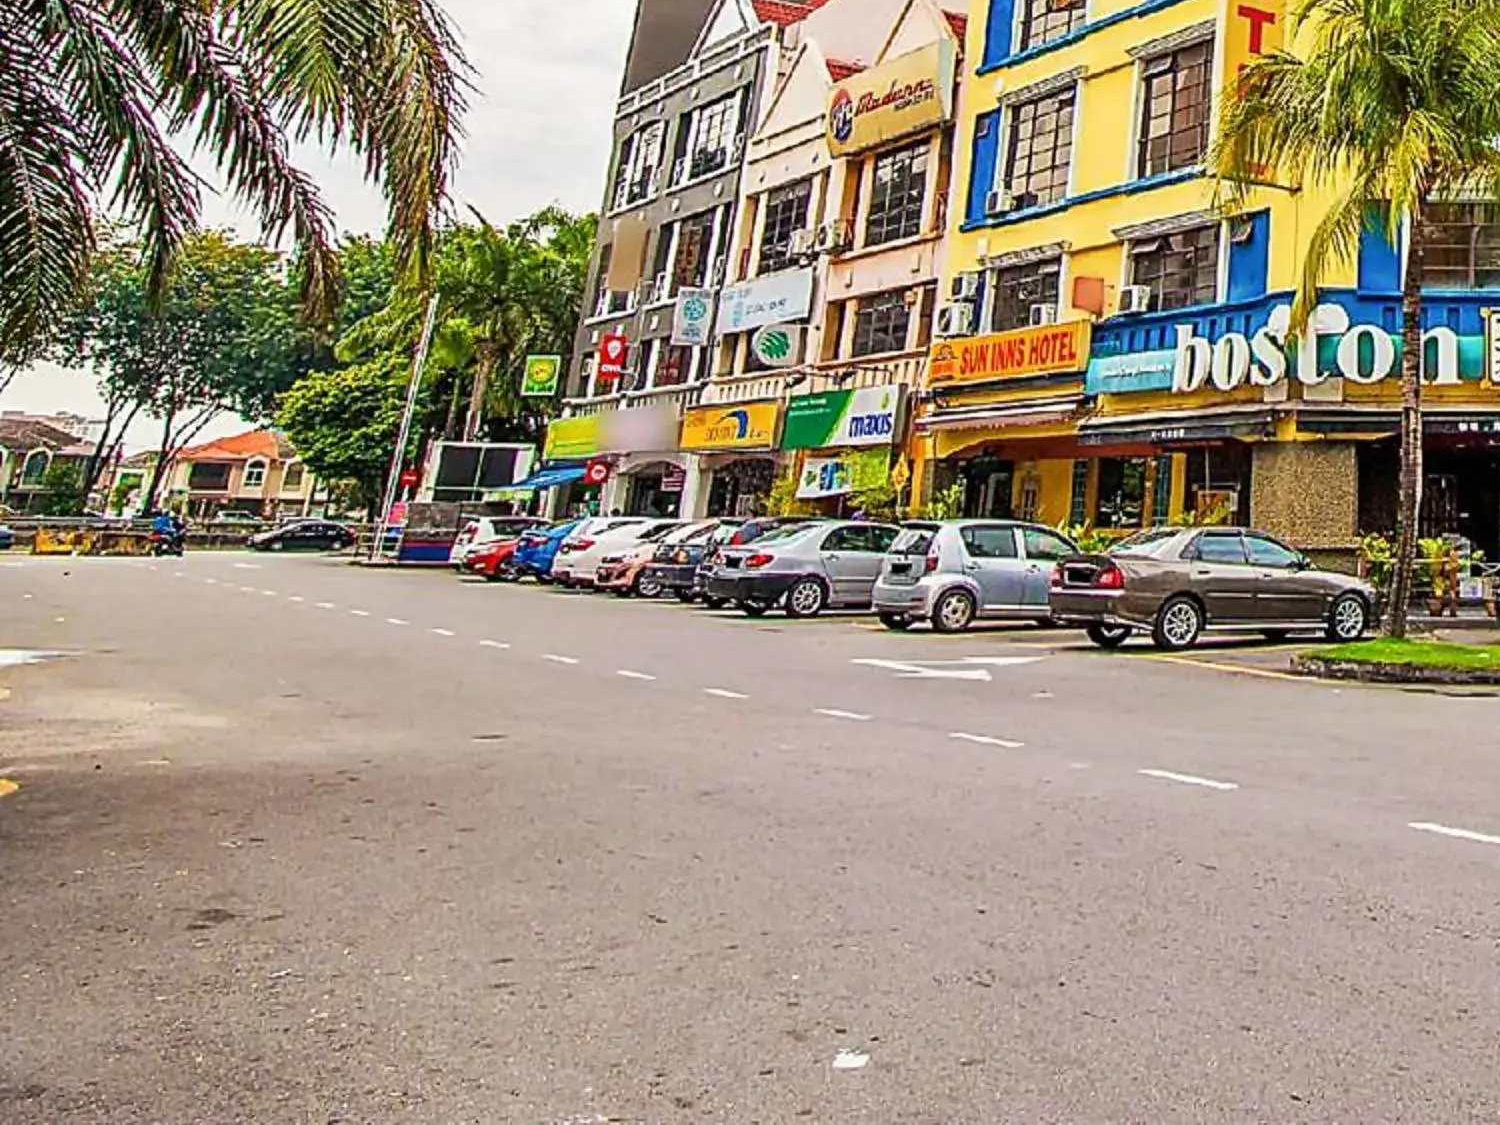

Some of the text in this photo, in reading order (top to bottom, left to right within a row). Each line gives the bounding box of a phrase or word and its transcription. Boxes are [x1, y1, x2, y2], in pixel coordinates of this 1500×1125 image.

[960, 331, 1077, 375] SUN INNS HOTEL
[849, 413, 893, 438] maxis
